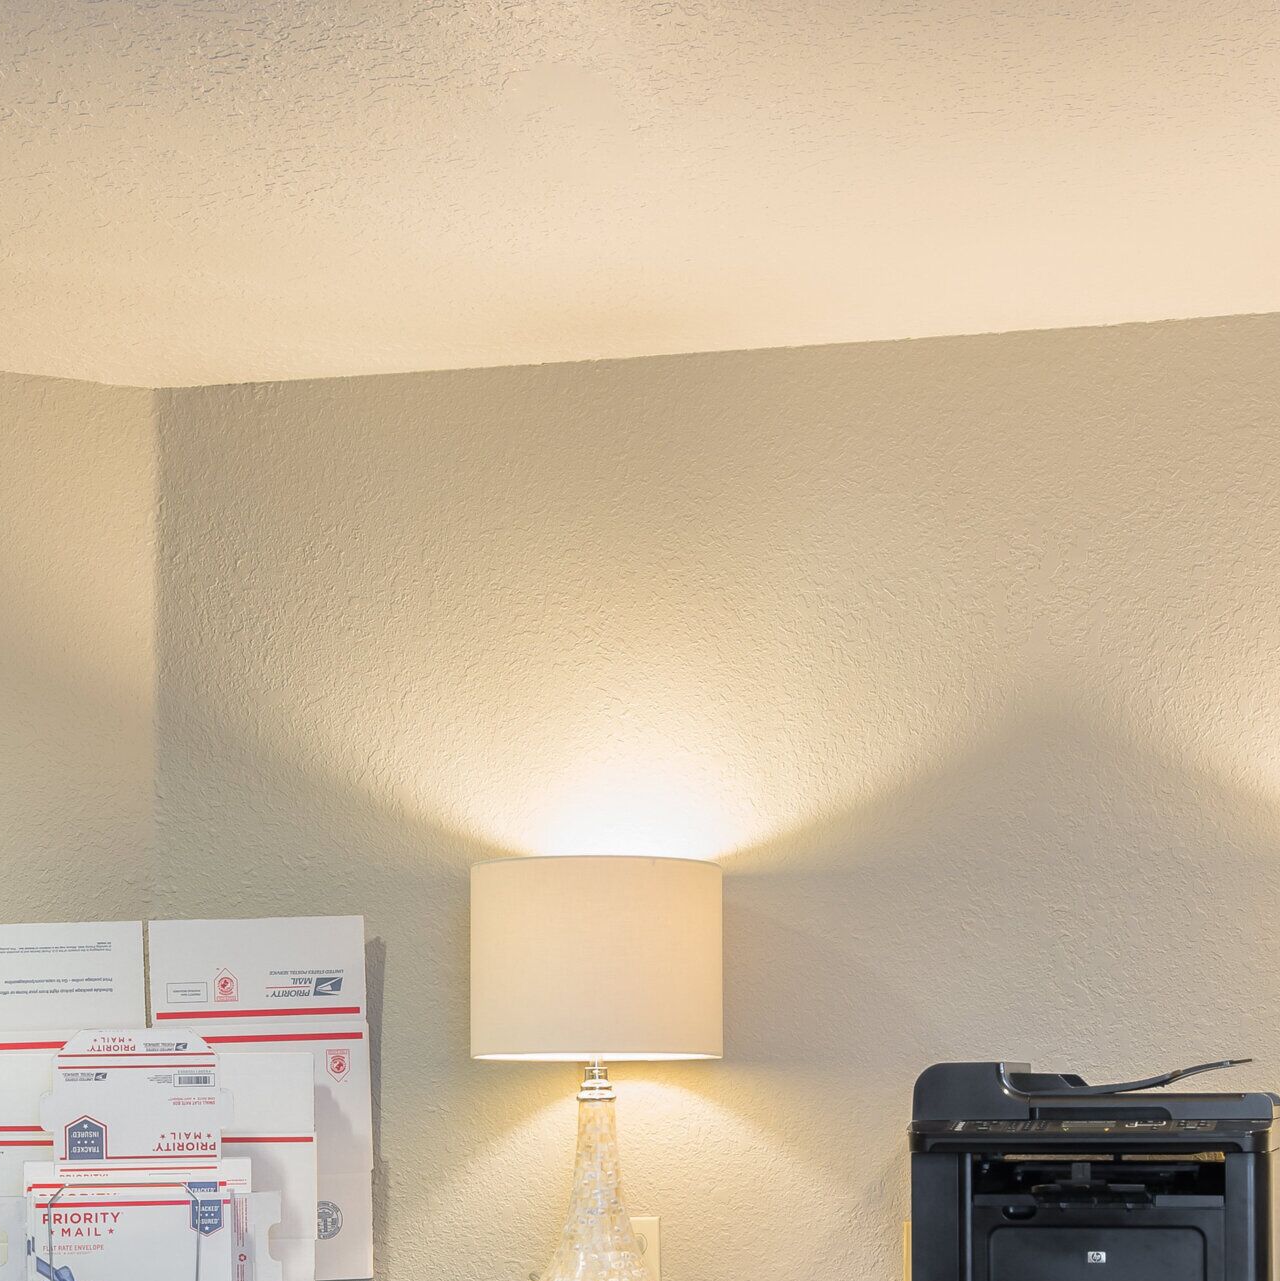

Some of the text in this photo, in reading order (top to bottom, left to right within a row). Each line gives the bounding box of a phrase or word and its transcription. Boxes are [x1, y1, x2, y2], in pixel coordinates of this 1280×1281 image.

[290, 977, 313, 985] MAIL
[270, 989, 311, 998] PRIORITY
[90, 1044, 136, 1052] PRIORITY
[170, 1132, 202, 1140] MAIL
[155, 1142, 217, 1152] PRIORITY
[42, 1212, 120, 1225] PRIORITY
[61, 1227, 102, 1237] MAIL
